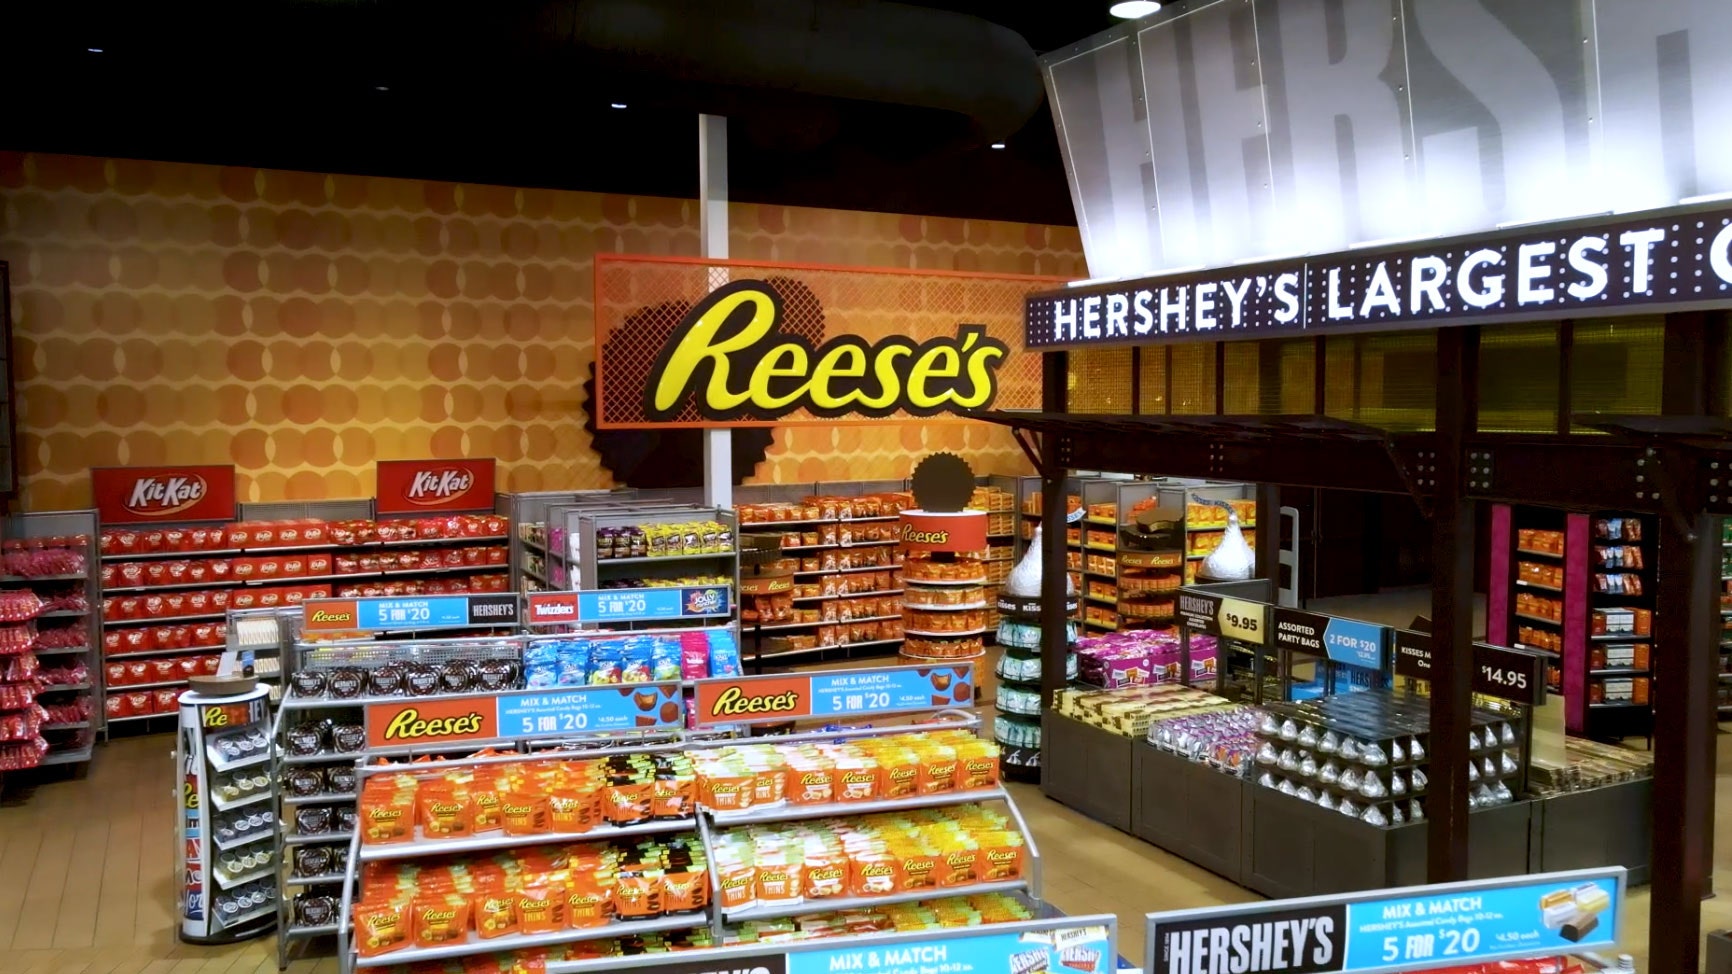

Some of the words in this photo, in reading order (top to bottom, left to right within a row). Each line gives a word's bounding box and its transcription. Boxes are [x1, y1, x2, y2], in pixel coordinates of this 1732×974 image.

[1054, 271, 1299, 341] HERSHEY'S
[1328, 229, 1665, 319] LARGEST
[653, 288, 1003, 412] Reese's
[902, 523, 949, 545] Reese's
[473, 604, 514, 617] HERSHEY'S
[535, 603, 575, 616] Twizzlers
[1180, 596, 1214, 615] HERSHEY'S
[312, 610, 351, 622] Reese's
[378, 609, 387, 621] 5
[1226, 613, 1258, 631] $9.95
[1278, 622, 1315, 635] ASSORTED
[1278, 633, 1300, 644] PARTY
[1301, 638, 1320, 649] BAGS
[1329, 634, 1336, 644] 2
[1337, 635, 1358, 648] FOR
[1359, 640, 1376, 652] $20
[1401, 646, 1423, 657] KISSES
[1418, 660, 1431, 669] One
[850, 677, 856, 685] &
[858, 675, 889, 685] MATCH
[1482, 665, 1527, 689] $14.95
[520, 697, 539, 707] MIX
[542, 697, 548, 706] &
[552, 695, 586, 705] MATCH
[713, 686, 798, 716] Reese's
[832, 696, 842, 711] 5
[846, 695, 863, 709] FOR
[865, 692, 890, 709] $20
[385, 709, 482, 740] Reese's
[522, 717, 533, 733] 5
[538, 715, 557, 731] FOR
[559, 713, 587, 731] $20
[765, 884, 785, 895] THINS
[1383, 903, 1411, 919] MIX
[1415, 902, 1425, 916] &
[1429, 897, 1482, 914] MATCH
[1169, 916, 1335, 974] HERSHEY'S
[1382, 937, 1399, 961] 5
[1405, 934, 1434, 959] FOR
[1439, 928, 1481, 955] $20
[830, 953, 863, 971] MIX
[868, 952, 880, 967] &
[885, 945, 947, 966] MATCH
